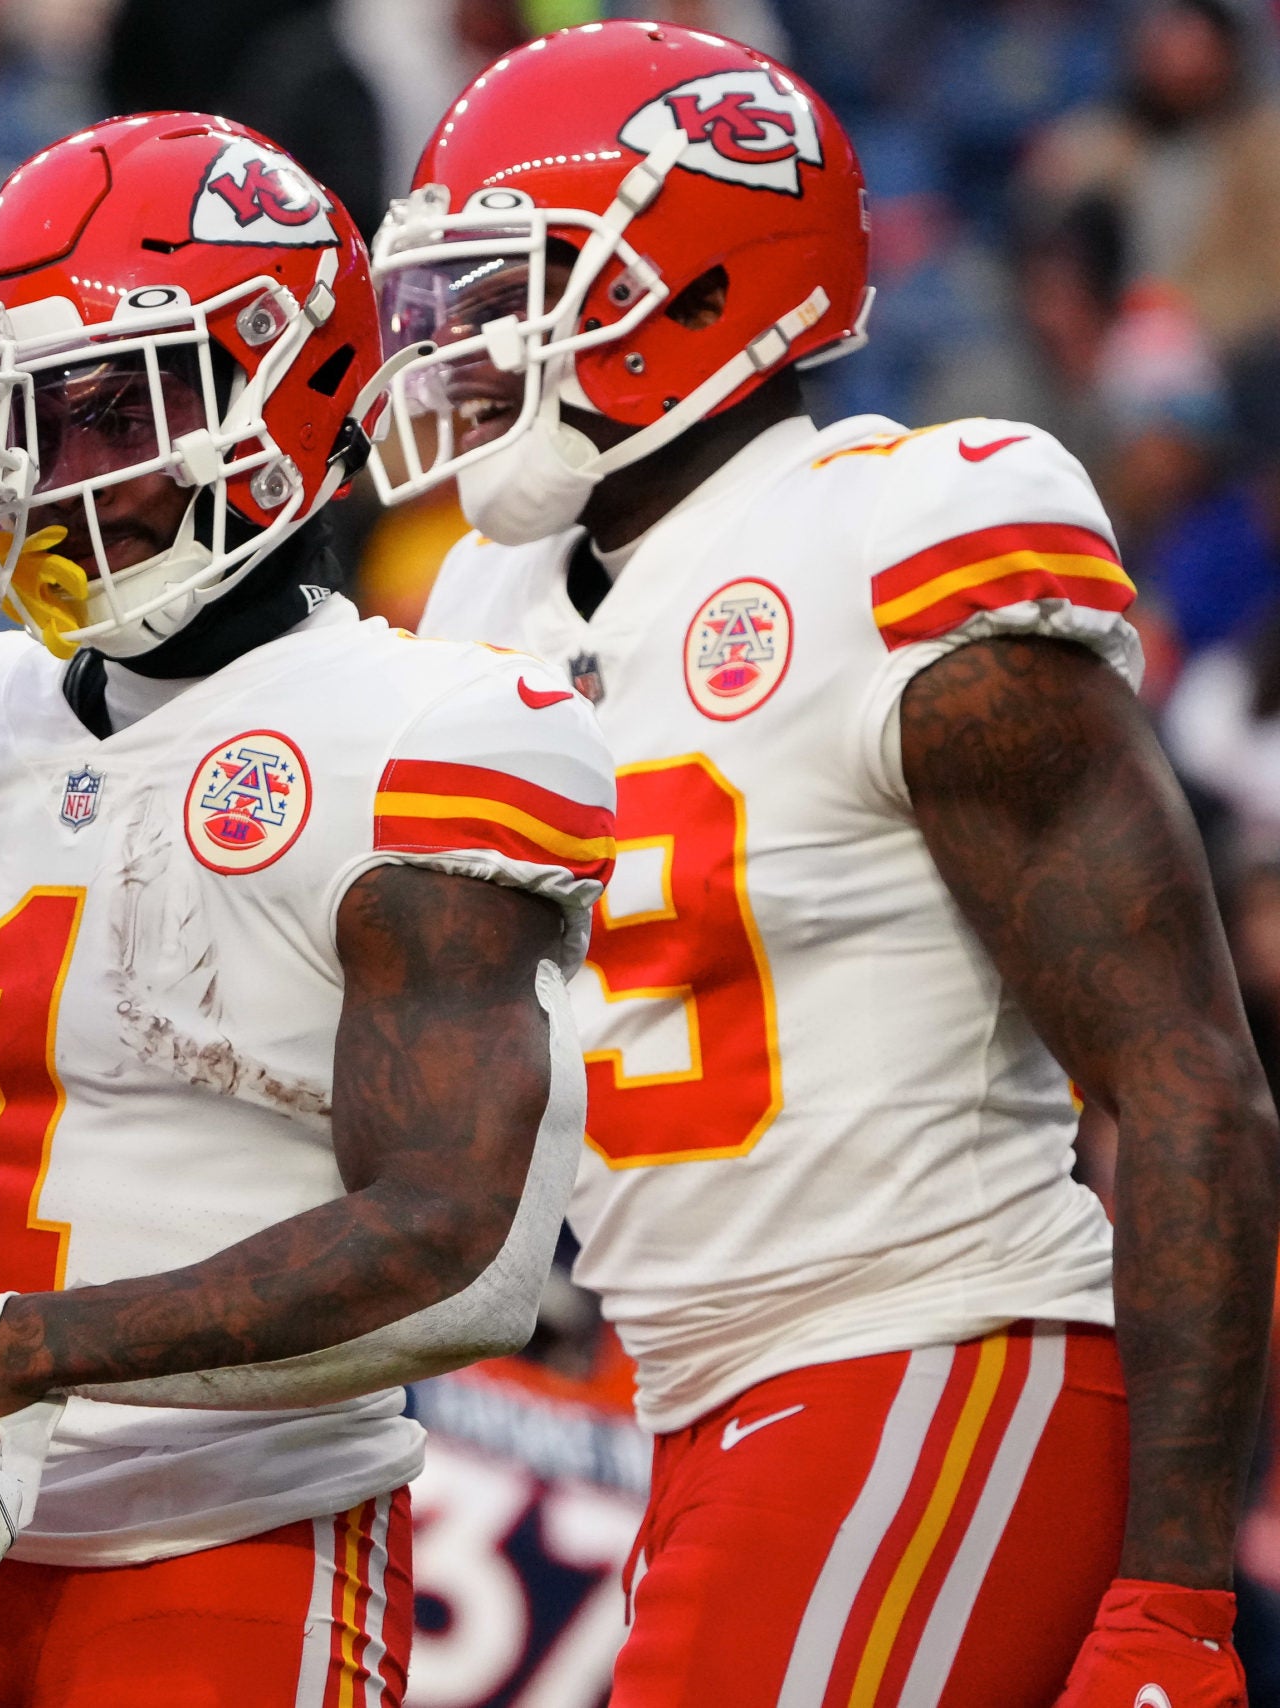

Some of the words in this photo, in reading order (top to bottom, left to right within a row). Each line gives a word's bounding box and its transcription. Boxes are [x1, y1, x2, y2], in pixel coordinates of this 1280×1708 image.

[664, 91, 799, 165] KC
[208, 158, 320, 228] KC
[64, 794, 92, 819] NFL
